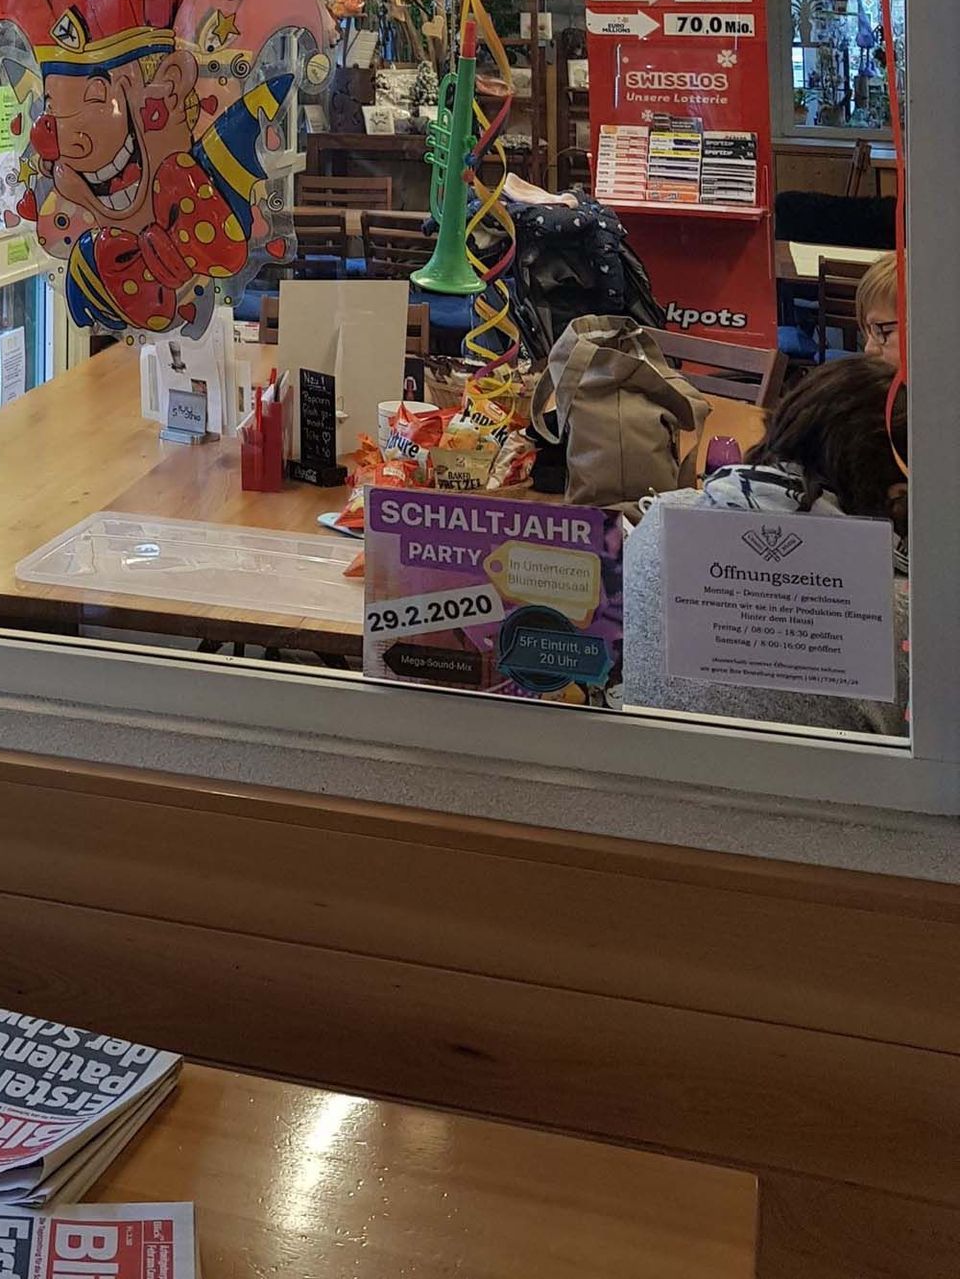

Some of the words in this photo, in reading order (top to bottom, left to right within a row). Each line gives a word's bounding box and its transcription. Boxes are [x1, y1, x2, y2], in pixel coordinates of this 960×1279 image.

[676, 17, 723, 35] 70,0
[725, 21, 753, 35] Mio.
[626, 71, 729, 91] SWISSLOS
[626, 92, 670, 103] Unsere
[673, 93, 729, 105] Lotterie
[666, 302, 747, 328] kpots
[380, 499, 592, 545] SCHALTJAHR
[408, 542, 482, 566] PARTY
[509, 558, 521, 570] In
[524, 560, 591, 579] Unterterzen
[709, 561, 844, 589] Öffnungszeiten
[704, 586, 735, 596] Montag
[743, 588, 791, 601] Donnerstag
[368, 593, 493, 633] 29.2.2020
[674, 595, 700, 606] Gerne
[779, 605, 794, 614] der
[796, 606, 843, 618] Produktion
[740, 612, 767, 621] Hinter
[769, 615, 787, 623] dem
[713, 623, 742, 633] Freitag
[810, 632, 844, 641] geöffnet
[584, 642, 599, 656] ab
[715, 635, 751, 647] Samstag
[808, 644, 842, 654] geöffnet
[539, 651, 556, 665] 20
[557, 653, 579, 668] Uhr
